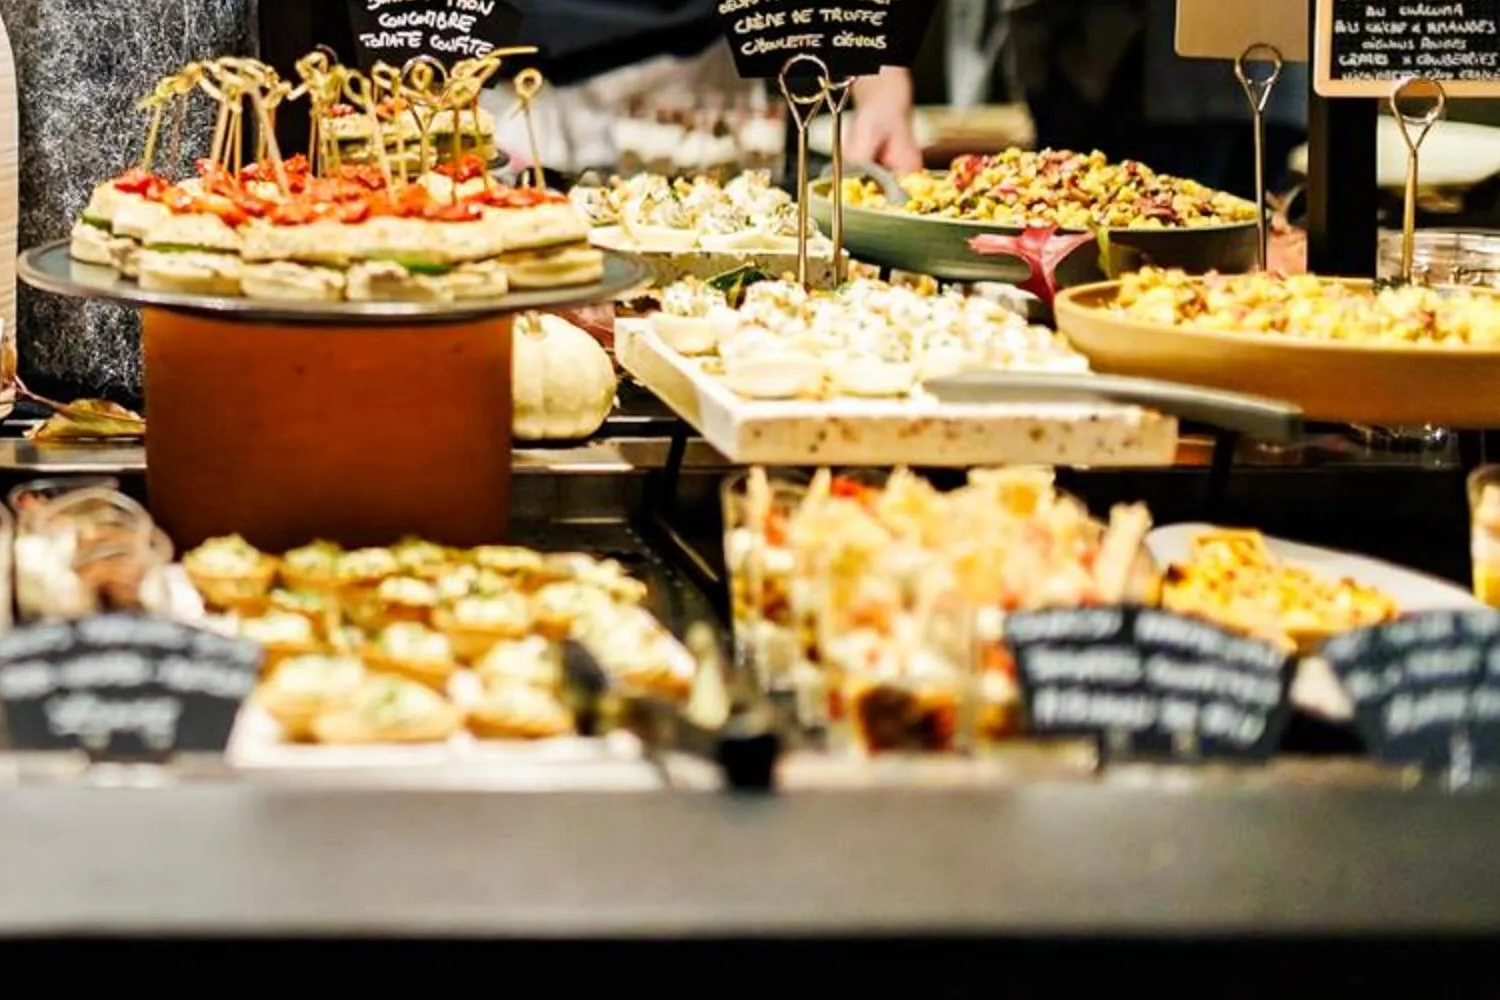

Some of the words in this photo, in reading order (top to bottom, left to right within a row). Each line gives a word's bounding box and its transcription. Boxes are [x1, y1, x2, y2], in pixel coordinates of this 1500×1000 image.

[378, 9, 477, 34] CONCOMBRE
[791, 8, 815, 25] DE
[359, 31, 423, 49] TOMATE
[430, 34, 495, 59] CONFITE
